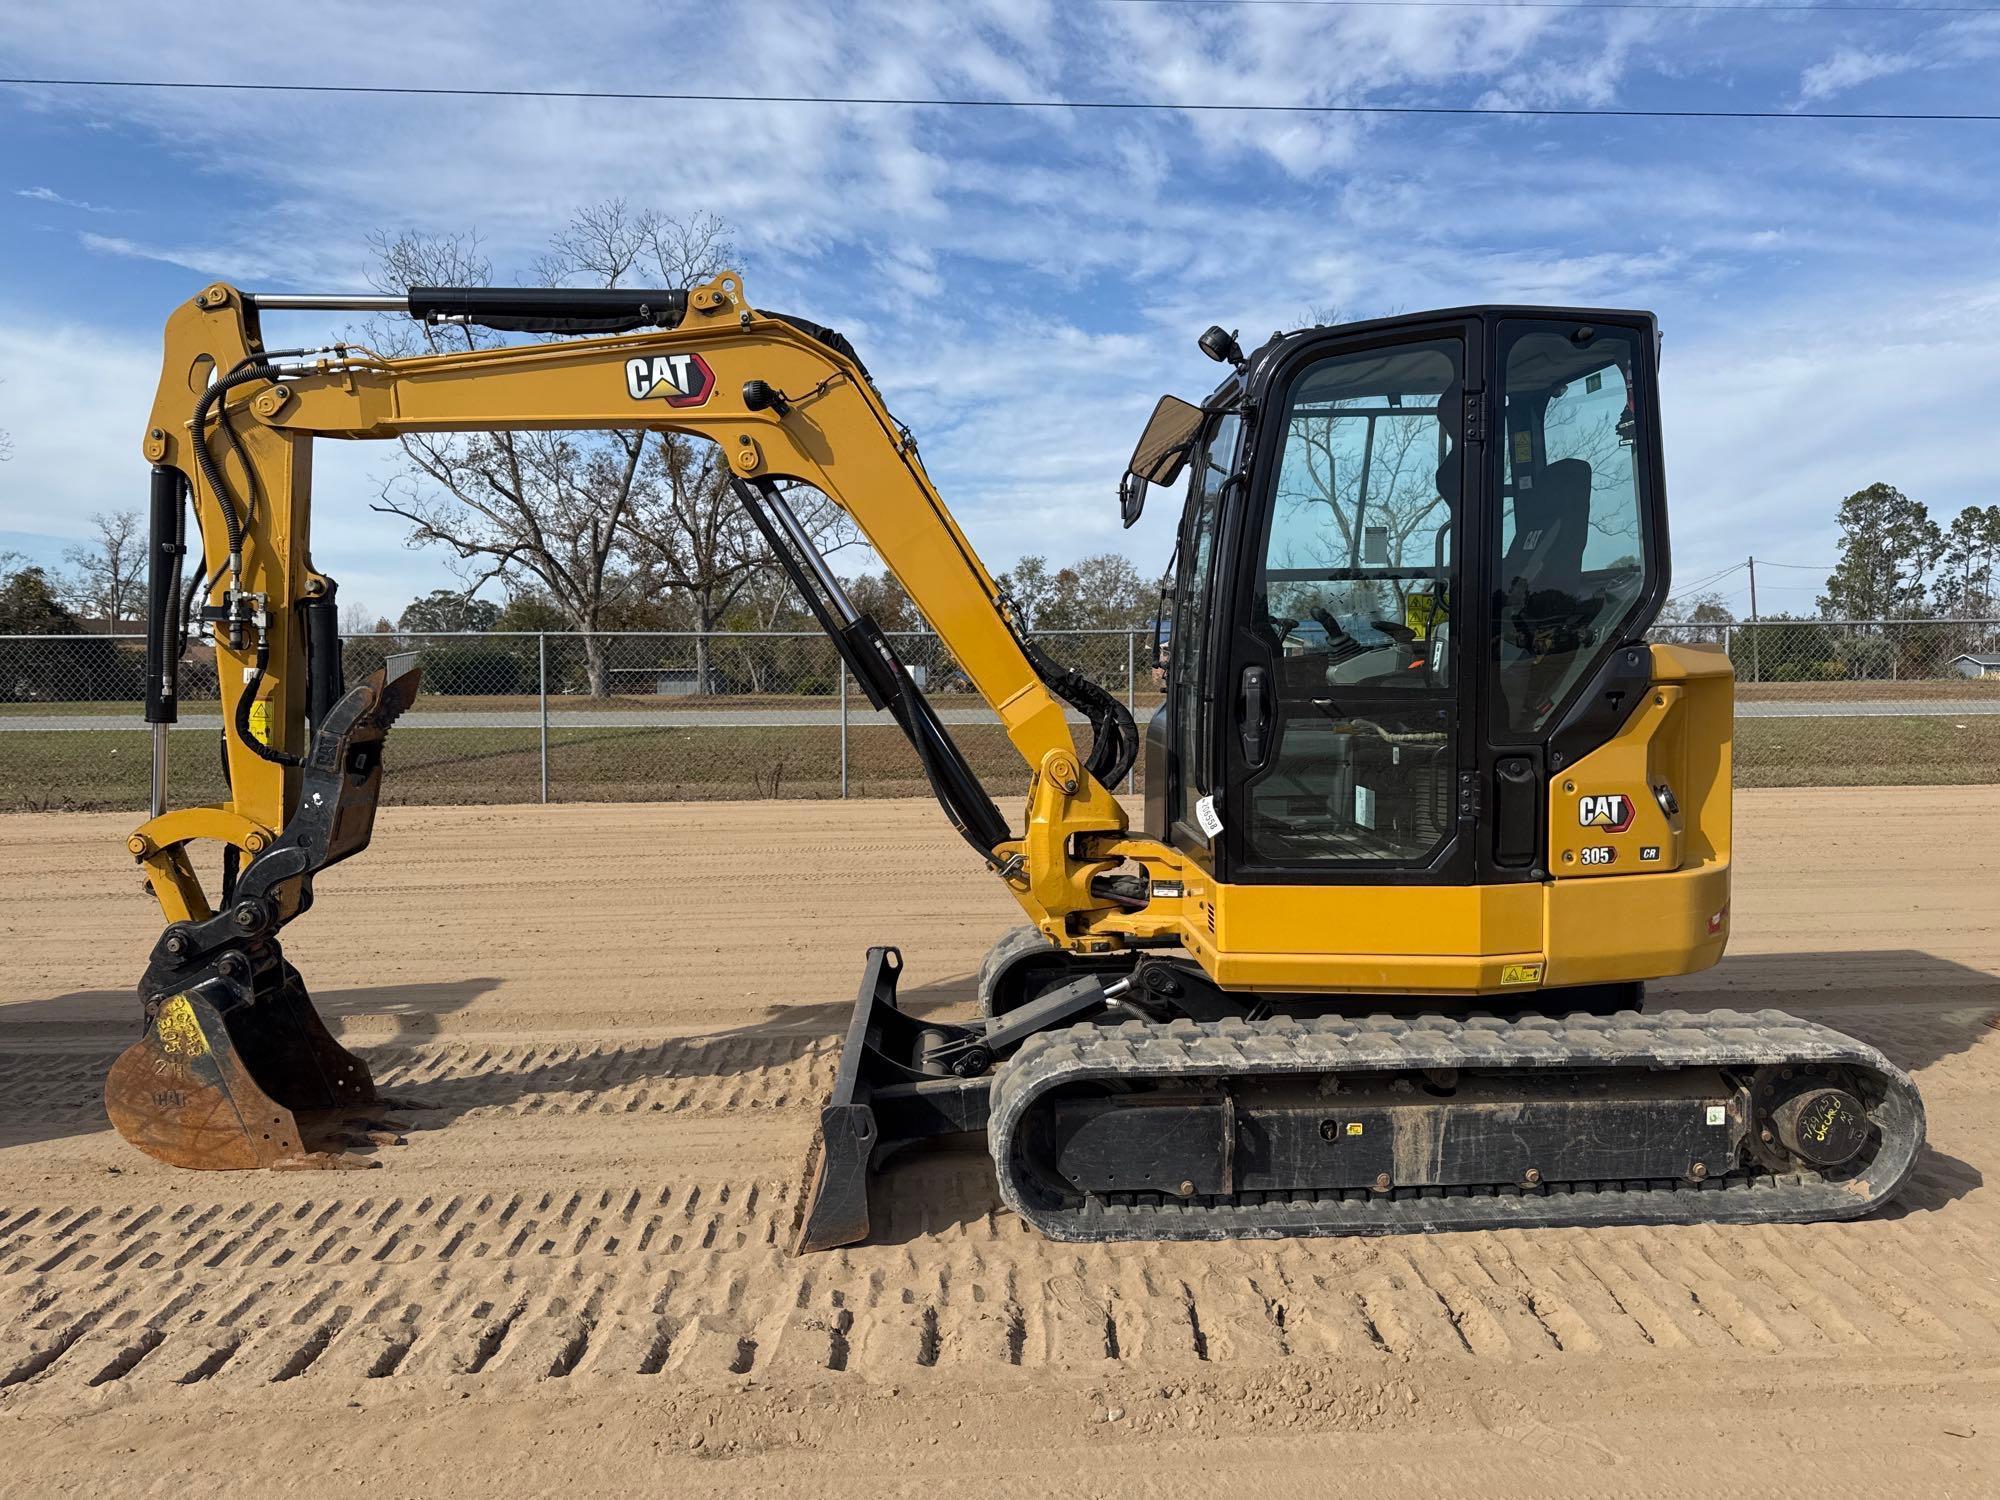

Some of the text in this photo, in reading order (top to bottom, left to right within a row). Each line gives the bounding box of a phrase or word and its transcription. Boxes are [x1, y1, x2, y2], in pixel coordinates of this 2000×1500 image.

[626, 354, 691, 399] CAT
[1522, 529, 1543, 550] CAT
[1580, 796, 1622, 826] CAT
[1581, 847, 1657, 865] 305 CR
